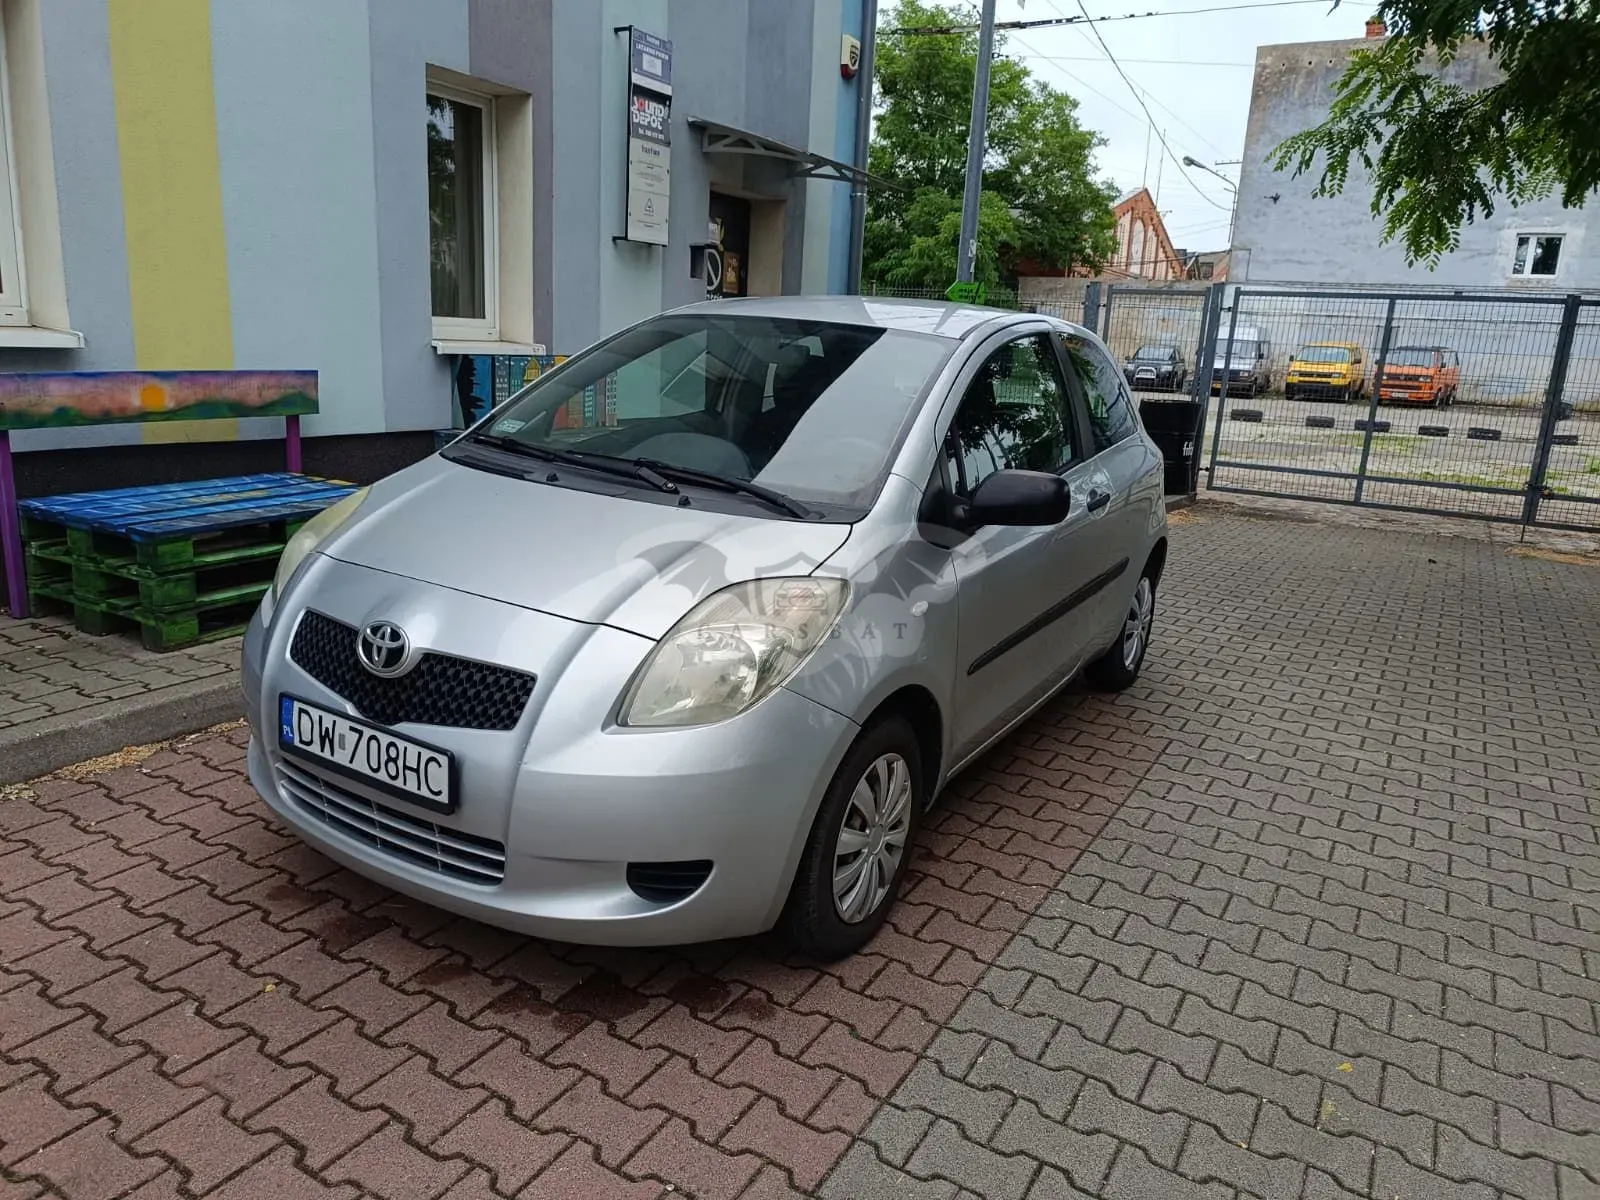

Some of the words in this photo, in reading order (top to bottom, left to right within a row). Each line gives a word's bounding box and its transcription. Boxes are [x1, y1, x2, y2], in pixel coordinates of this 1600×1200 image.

[633, 110, 662, 130] DEPOT
[283, 725, 293, 737] PL
[298, 707, 336, 757] DW
[349, 725, 443, 796] 708HC
